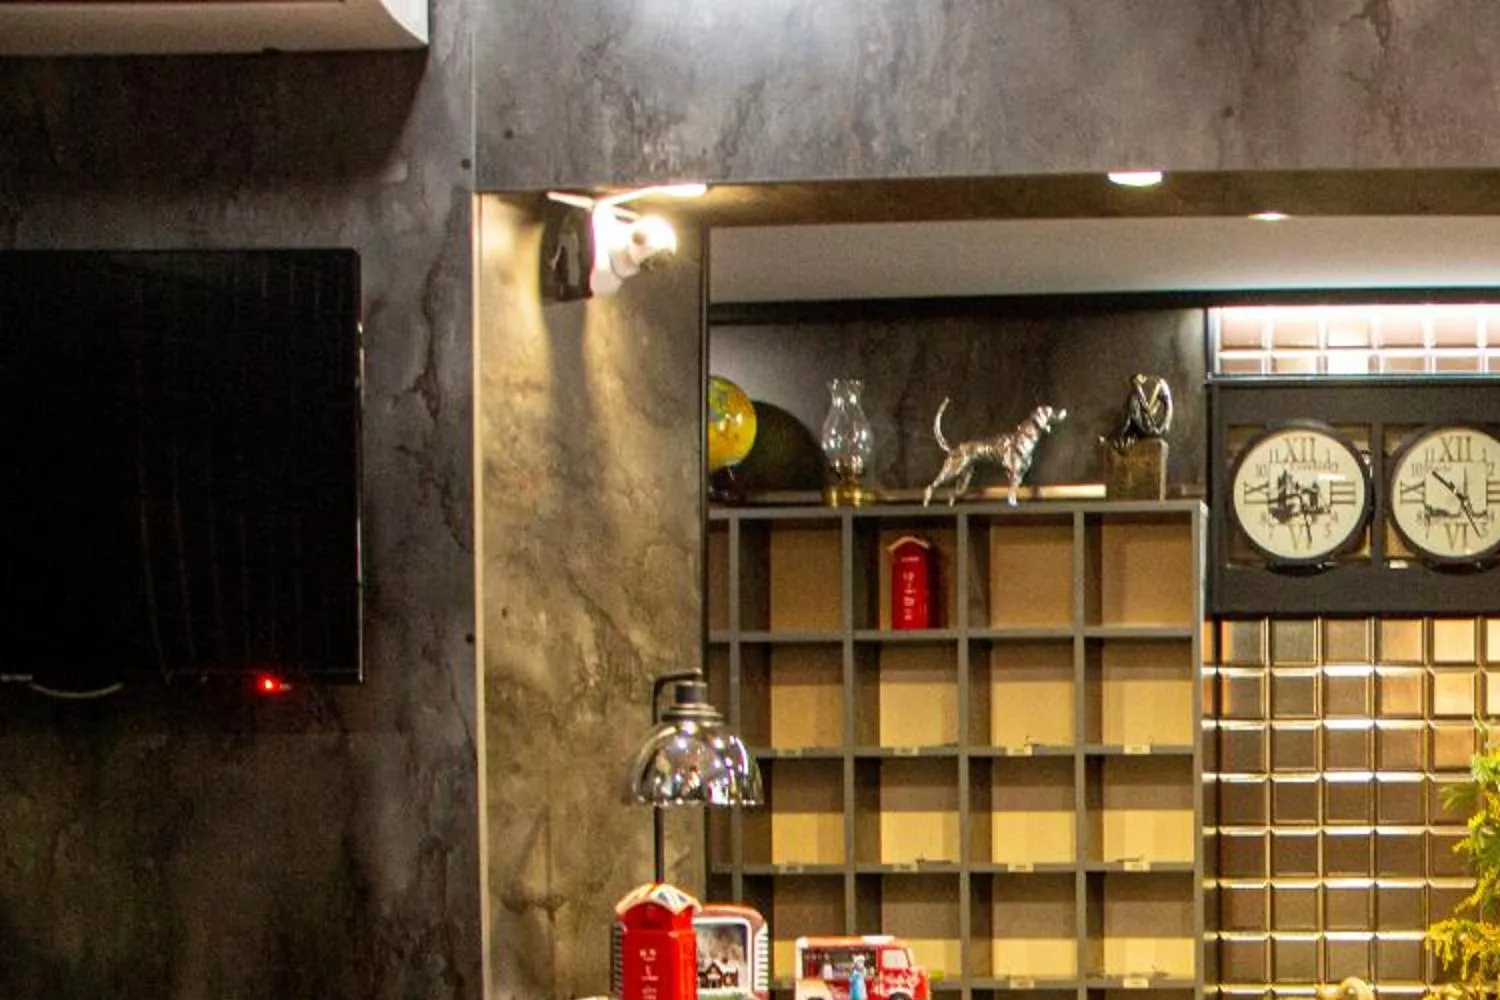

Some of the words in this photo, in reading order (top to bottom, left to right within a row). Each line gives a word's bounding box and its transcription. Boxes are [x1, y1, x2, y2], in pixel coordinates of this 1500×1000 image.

[1283, 437, 1316, 462] XII
[1440, 435, 1472, 463] XII
[1329, 480, 1356, 505] III
[1444, 522, 1469, 551] VI
